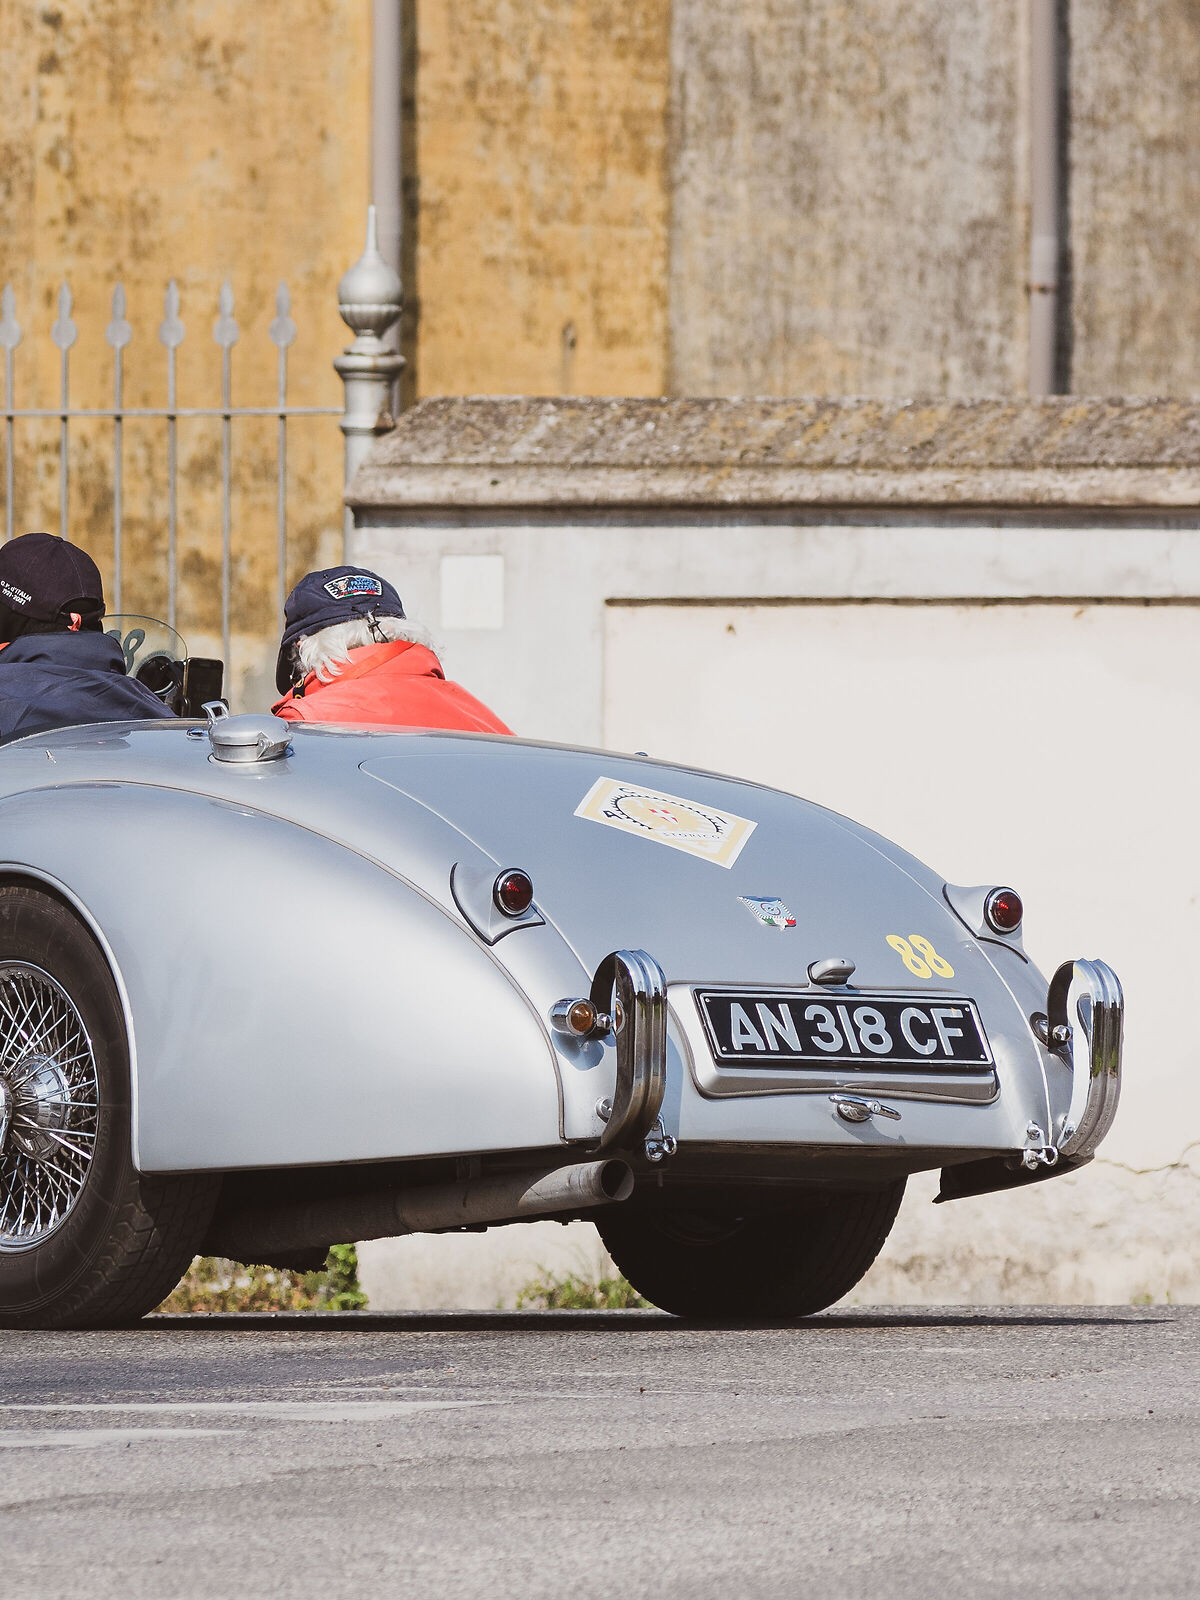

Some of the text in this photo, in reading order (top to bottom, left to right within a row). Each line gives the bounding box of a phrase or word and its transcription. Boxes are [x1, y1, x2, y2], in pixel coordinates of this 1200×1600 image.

[886, 934, 955, 979] 88
[730, 1002, 964, 1056] AN 318 CF
